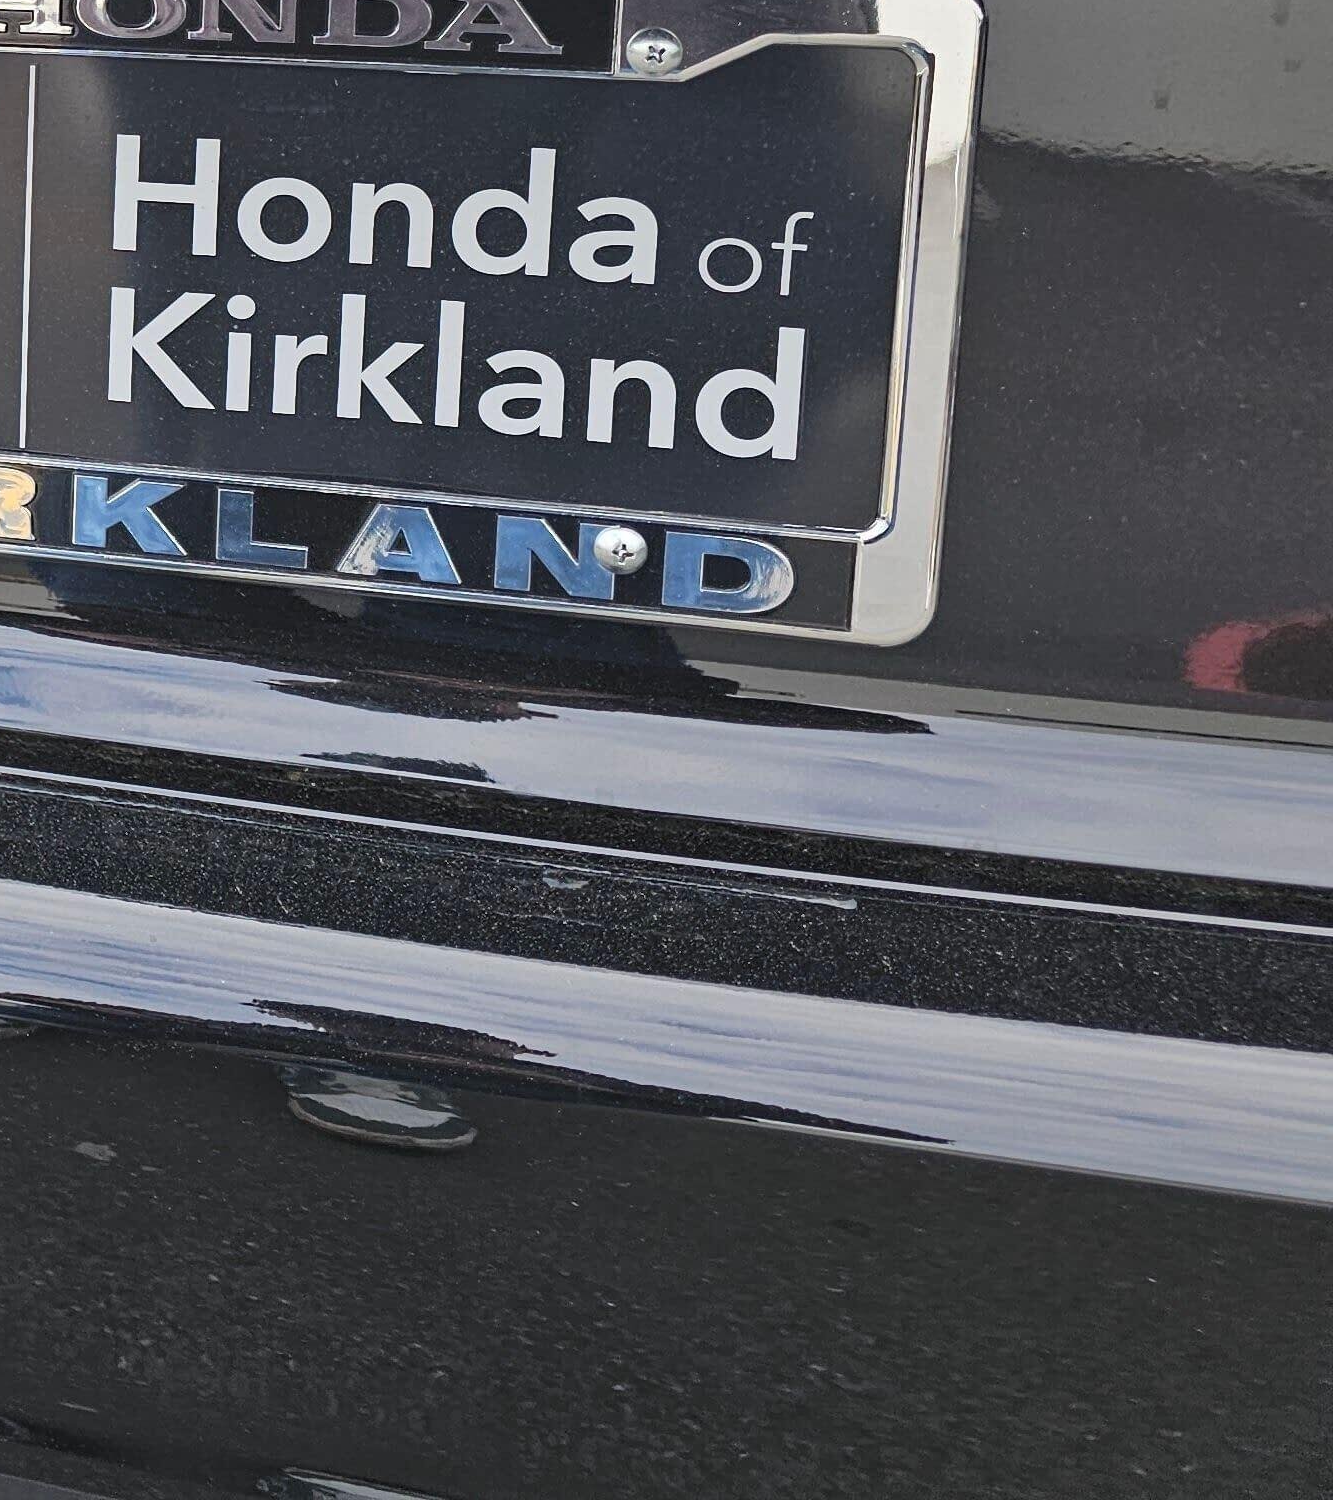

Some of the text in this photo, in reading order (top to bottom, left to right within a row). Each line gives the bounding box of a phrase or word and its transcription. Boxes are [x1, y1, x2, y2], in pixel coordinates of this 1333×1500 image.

[111, 133, 814, 296] Honda of
[106, 286, 806, 461] Kirkland
